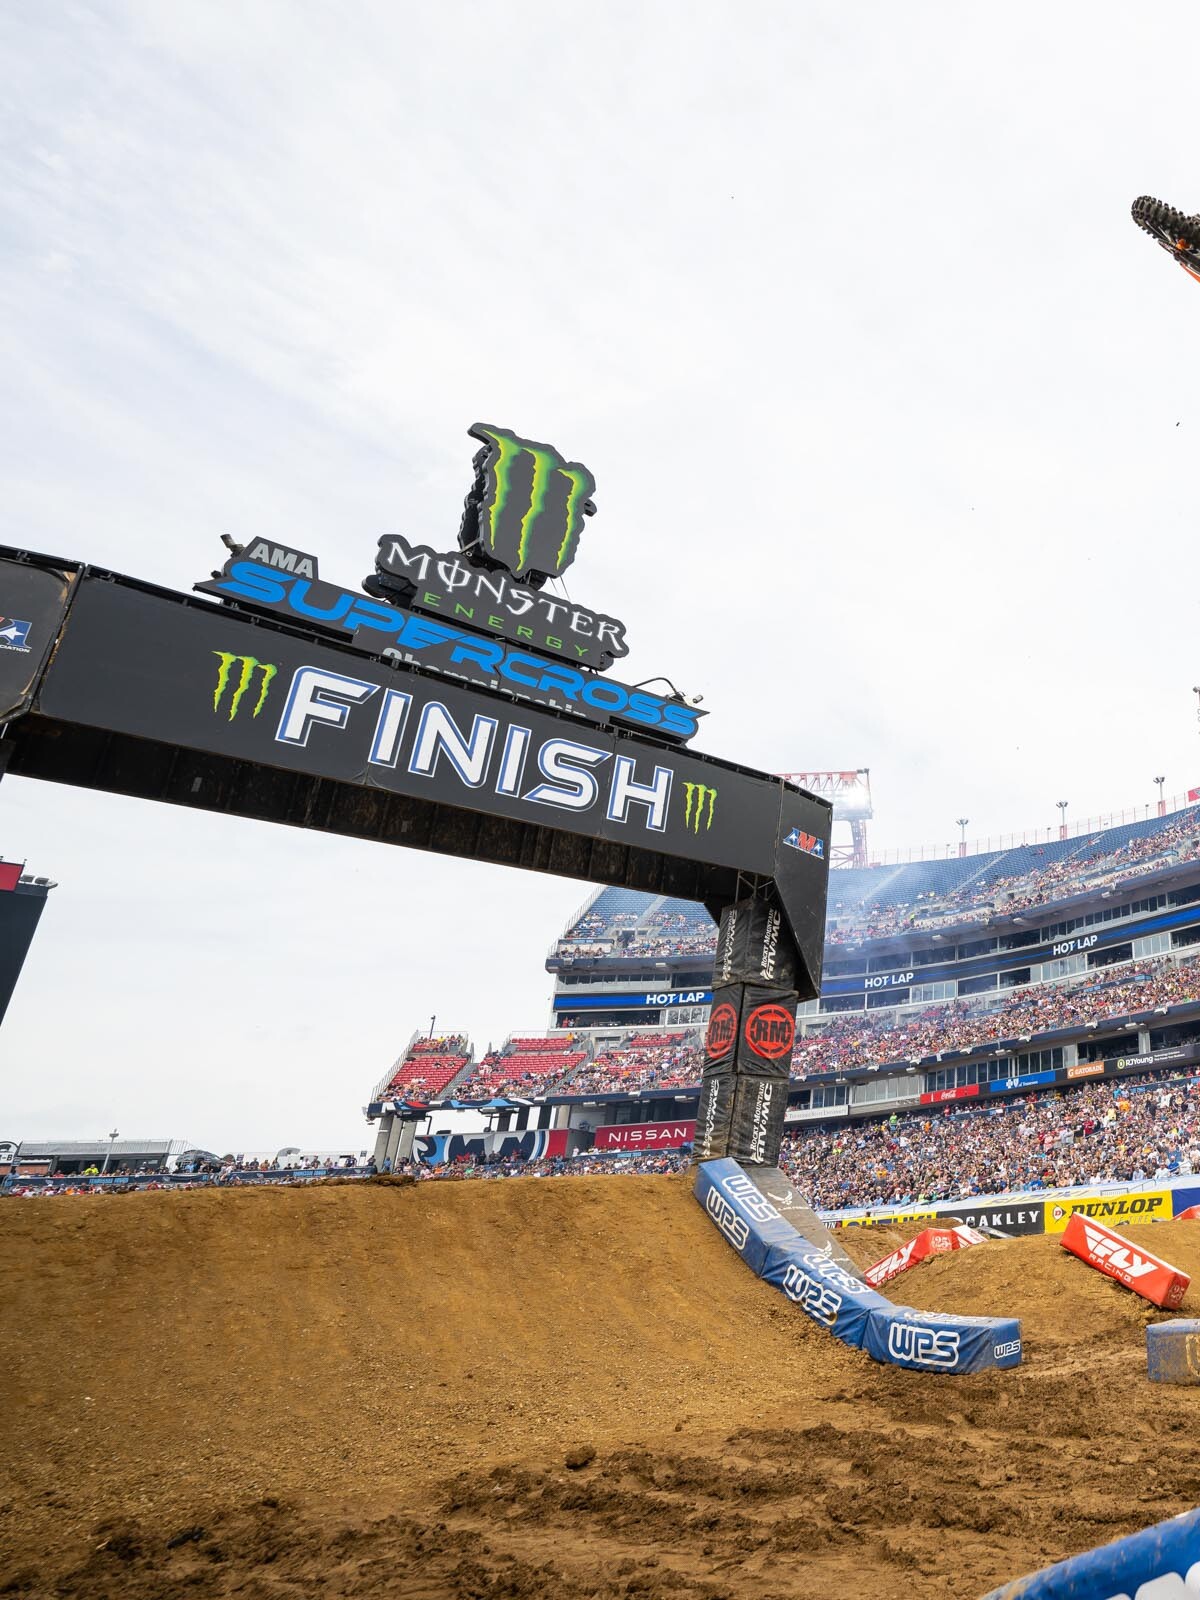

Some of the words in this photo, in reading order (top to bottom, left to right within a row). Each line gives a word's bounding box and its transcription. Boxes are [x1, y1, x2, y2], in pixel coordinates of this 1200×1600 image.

[250, 543, 313, 578] AMA
[387, 541, 623, 652] MONSTER
[424, 592, 589, 659] ENERGY
[216, 561, 699, 735] SUPERCROSS
[275, 665, 674, 833] FINISH
[783, 827, 824, 860] AMA
[1053, 941, 1076, 955] HOT
[1078, 935, 1097, 949] LAP
[646, 994, 677, 1005] HOT
[679, 992, 704, 1003] LAP
[865, 976, 889, 989] HOT
[892, 972, 914, 984] LAP
[1075, 1065, 1102, 1075] GATORADE
[754, 1082, 765, 1121] MOUNTAIN
[609, 1128, 687, 1143] NISSAN
[721, 1174, 781, 1222] WPS
[1069, 1197, 1163, 1218] DUNLOP
[706, 1185, 750, 1250] WPS
[965, 1210, 1040, 1227] OAKLEY
[866, 1240, 917, 1284] FLY
[1084, 1225, 1159, 1277] FLY
[1089, 1253, 1134, 1283] RACING
[782, 1264, 842, 1325] WPS
[888, 1322, 961, 1367] WPS
[993, 1339, 1021, 1359] WPS
